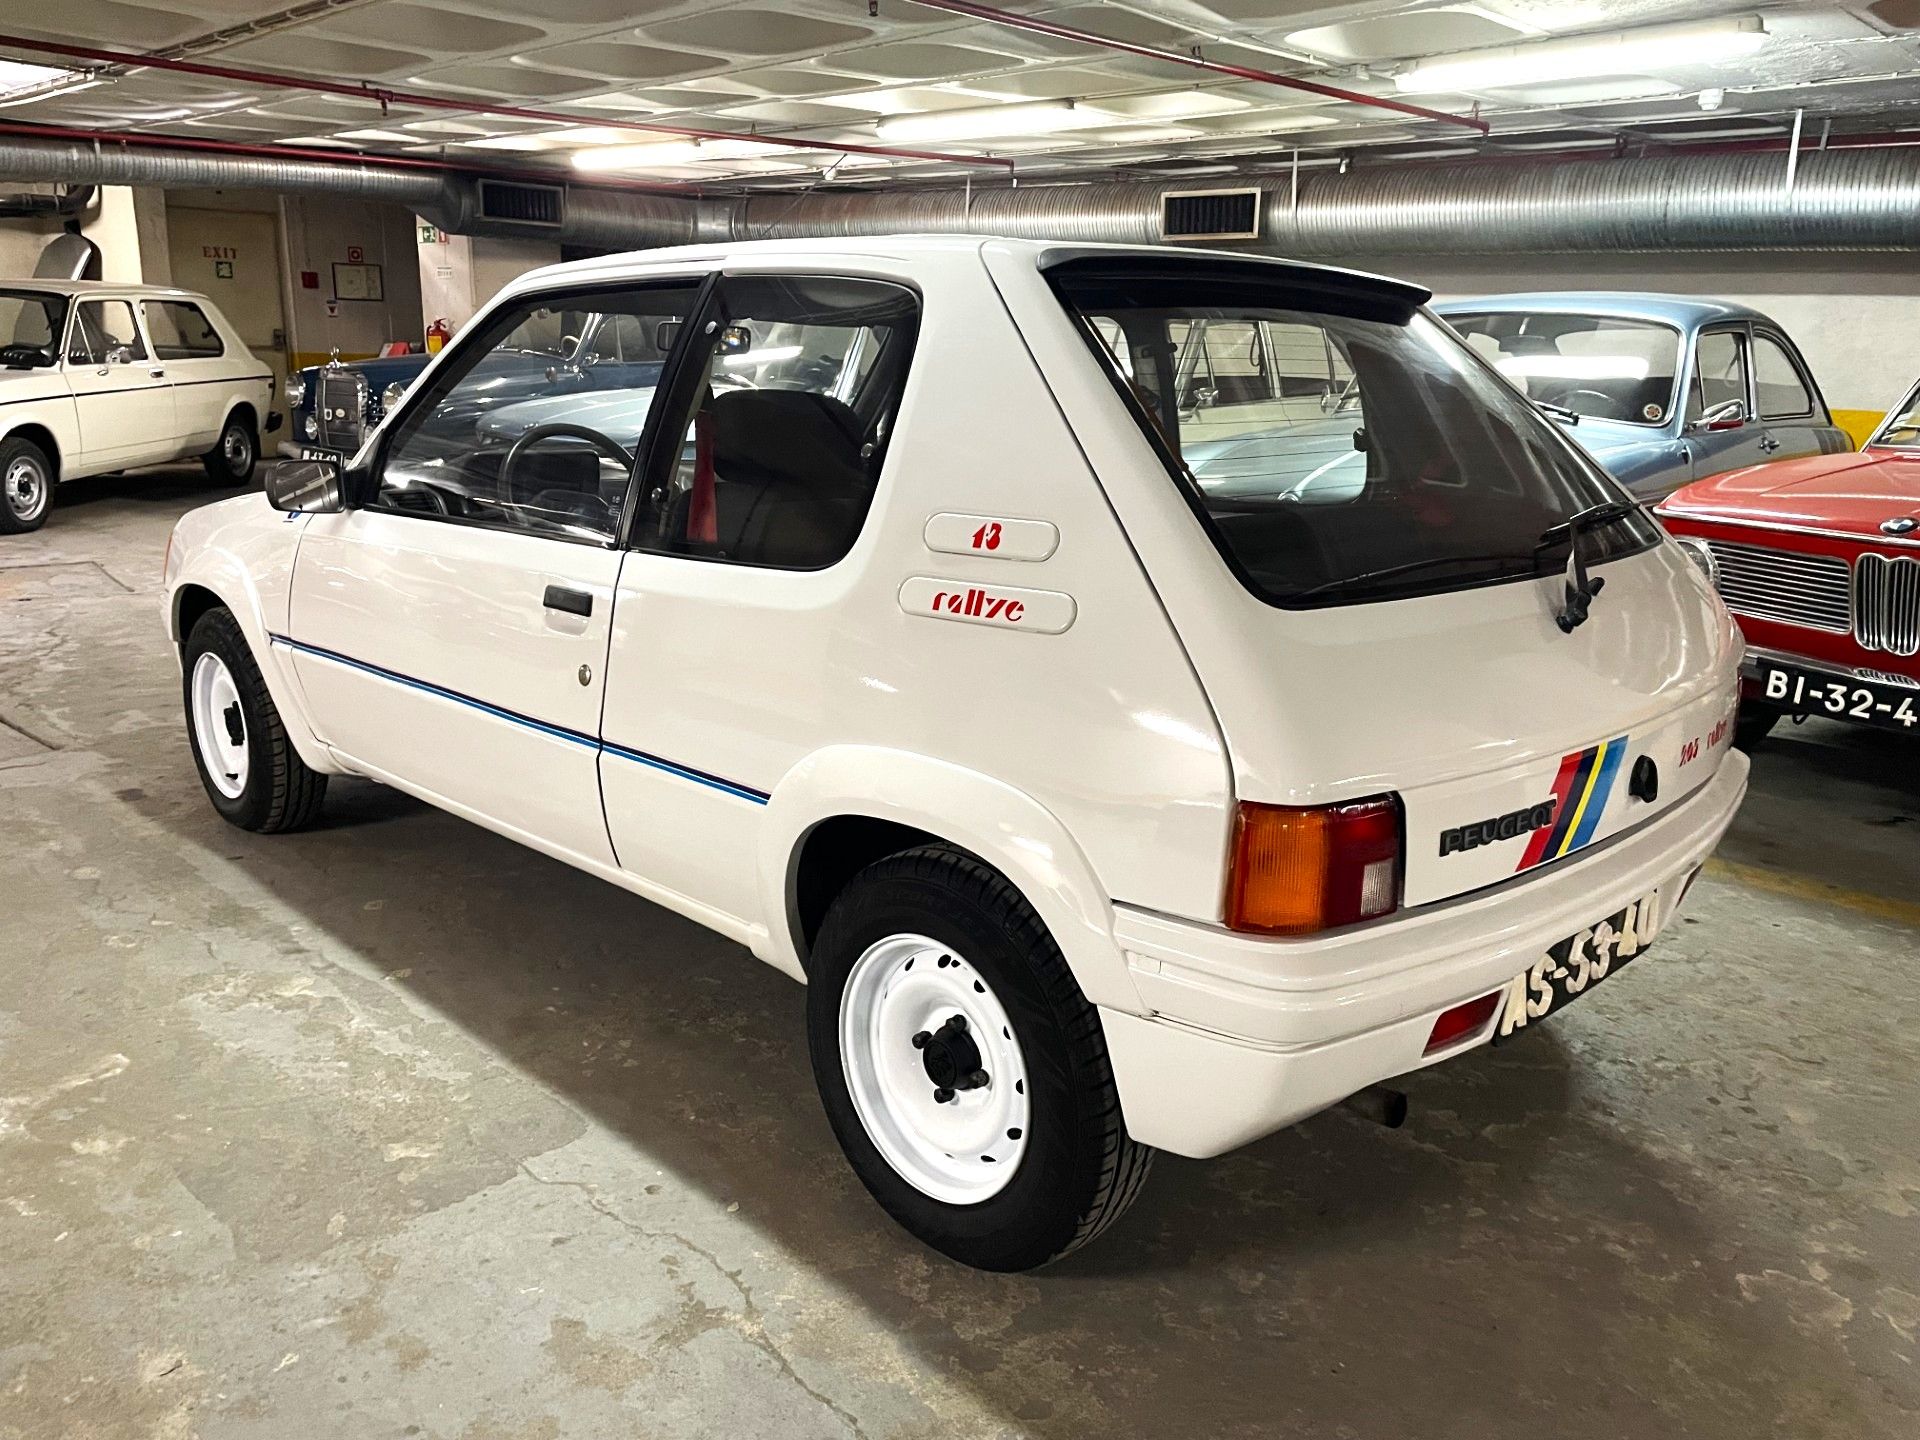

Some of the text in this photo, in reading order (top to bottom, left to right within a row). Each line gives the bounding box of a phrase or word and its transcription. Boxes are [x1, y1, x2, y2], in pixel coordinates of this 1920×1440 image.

[202, 246, 238, 259] EXIT
[932, 588, 1025, 622] rallye
[1439, 798, 1557, 857] PEUGEOT
